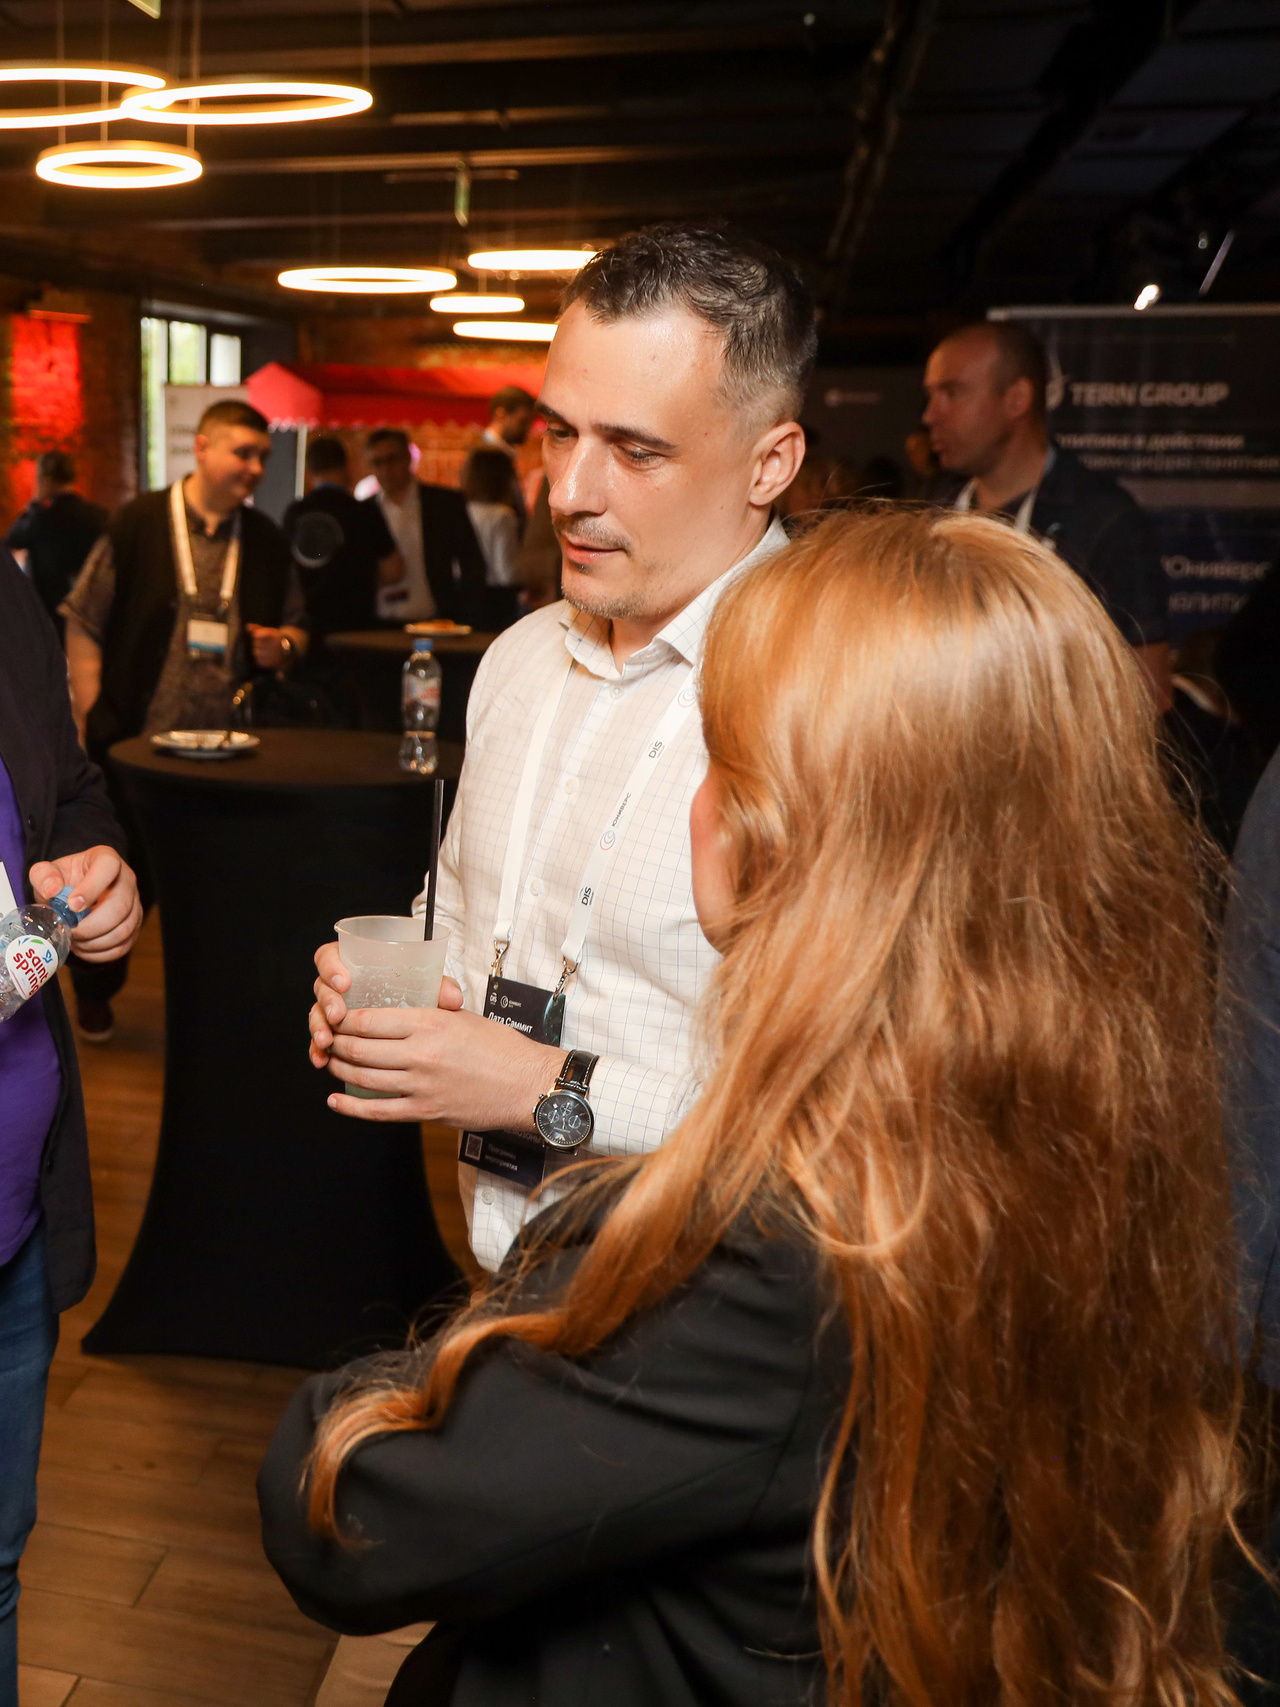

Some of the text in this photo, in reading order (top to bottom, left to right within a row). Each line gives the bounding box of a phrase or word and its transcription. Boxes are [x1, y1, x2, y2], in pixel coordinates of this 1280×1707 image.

[1071, 382, 1230, 407] TERN GROUP
[648, 741, 663, 758] DIS
[581, 886, 592, 906] DIS
[12, 952, 40, 996] spring
[25, 948, 49, 983] saint
[488, 1011, 533, 1034] Дата Саммит
